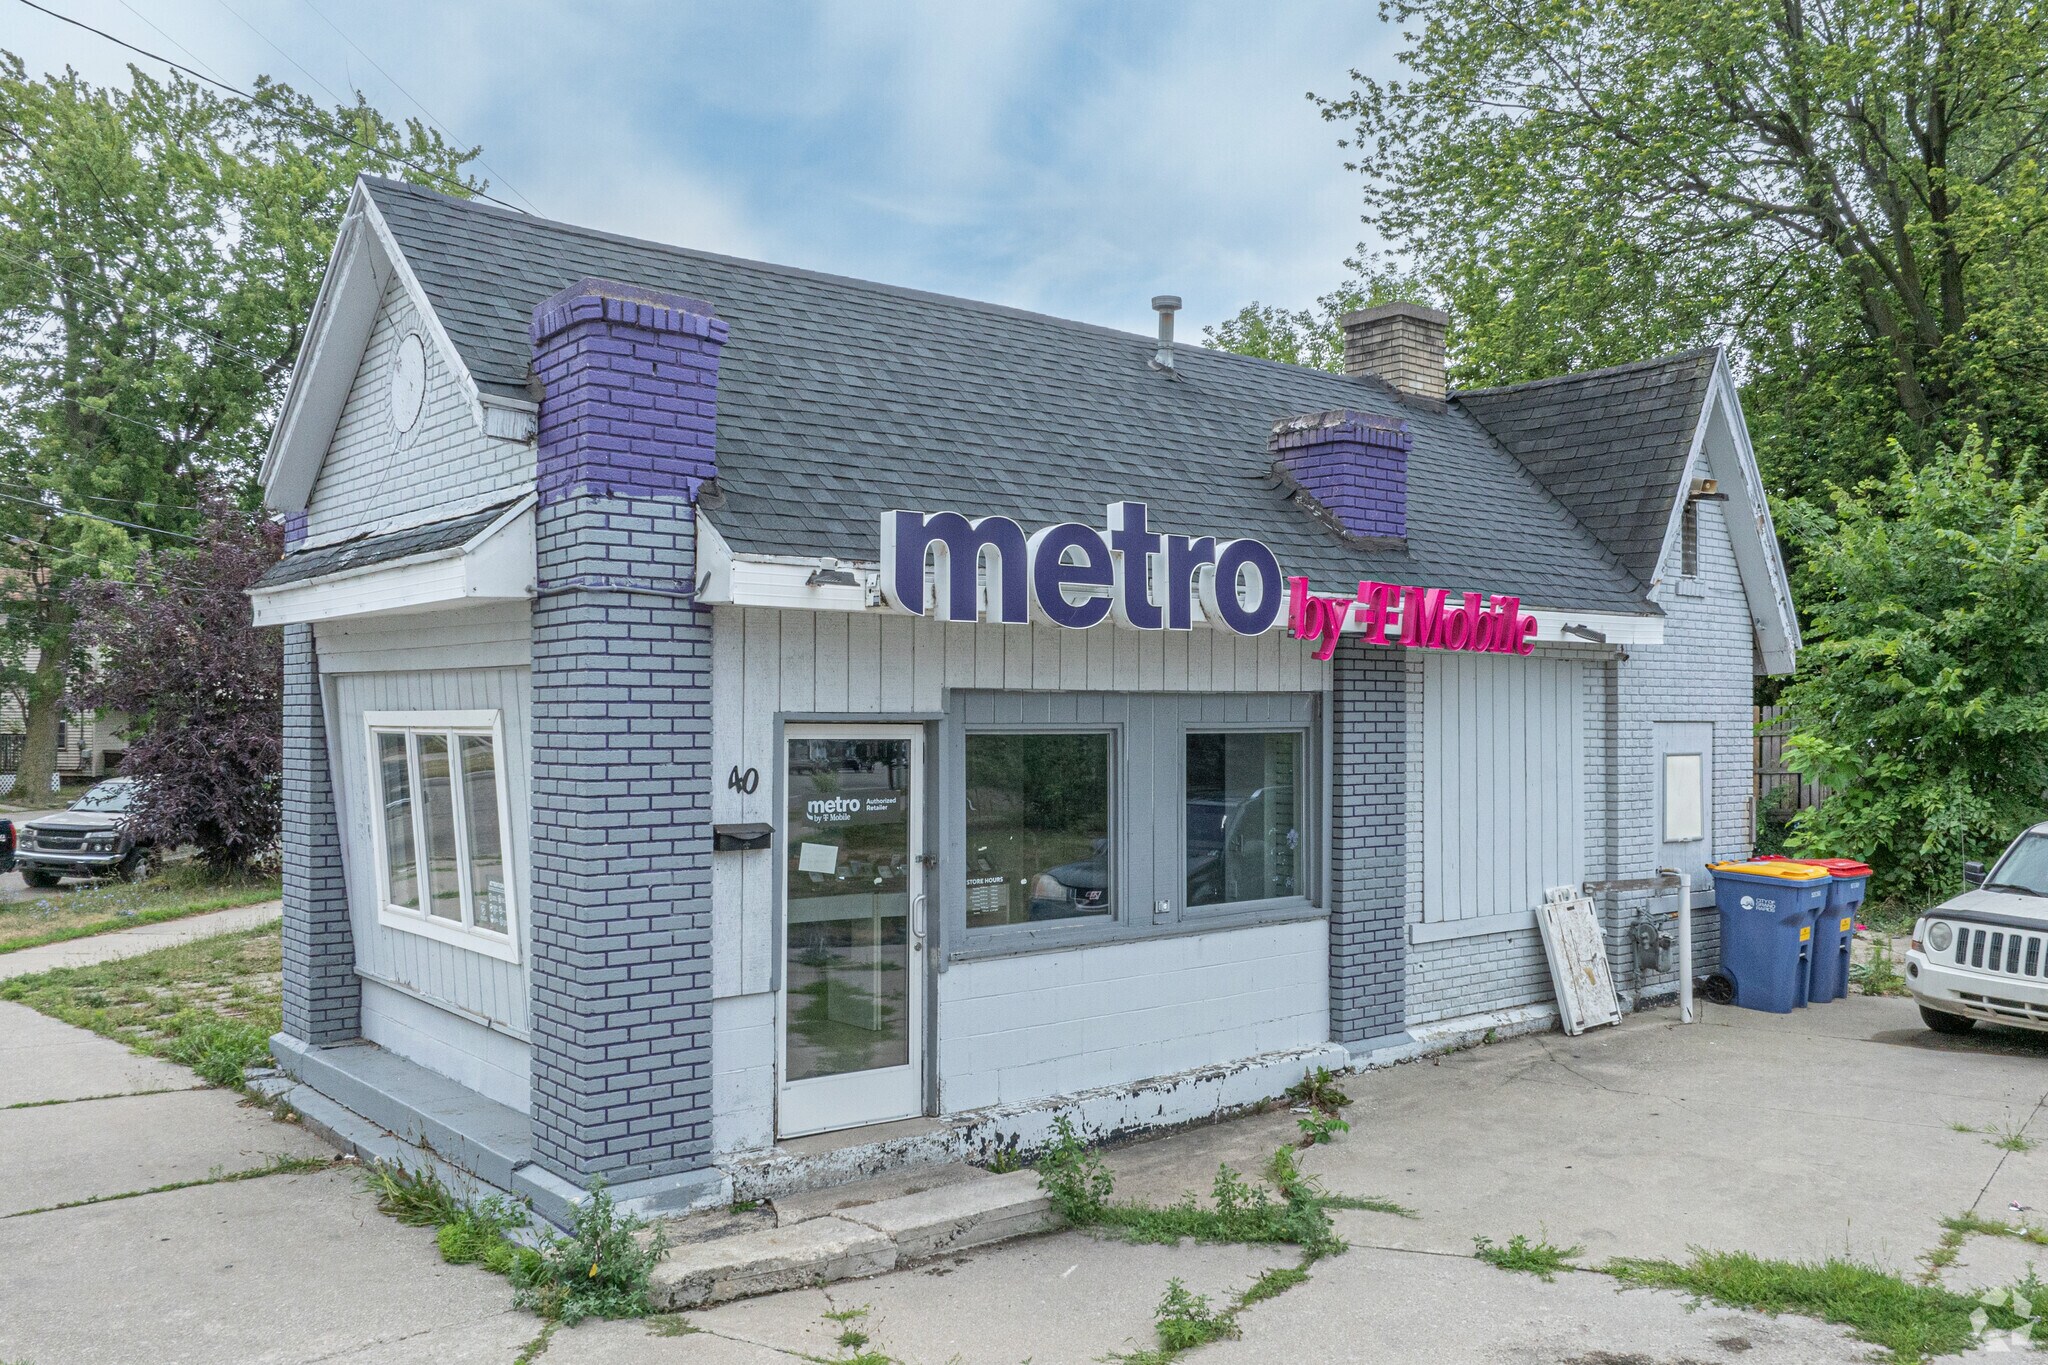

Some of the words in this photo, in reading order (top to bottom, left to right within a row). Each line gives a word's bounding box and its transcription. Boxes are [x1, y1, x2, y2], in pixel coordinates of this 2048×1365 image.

[881, 501, 1282, 636] metro
[1287, 576, 1352, 661] by
[728, 765, 759, 794] 40
[807, 796, 860, 815] metro
[813, 814, 822, 823] by
